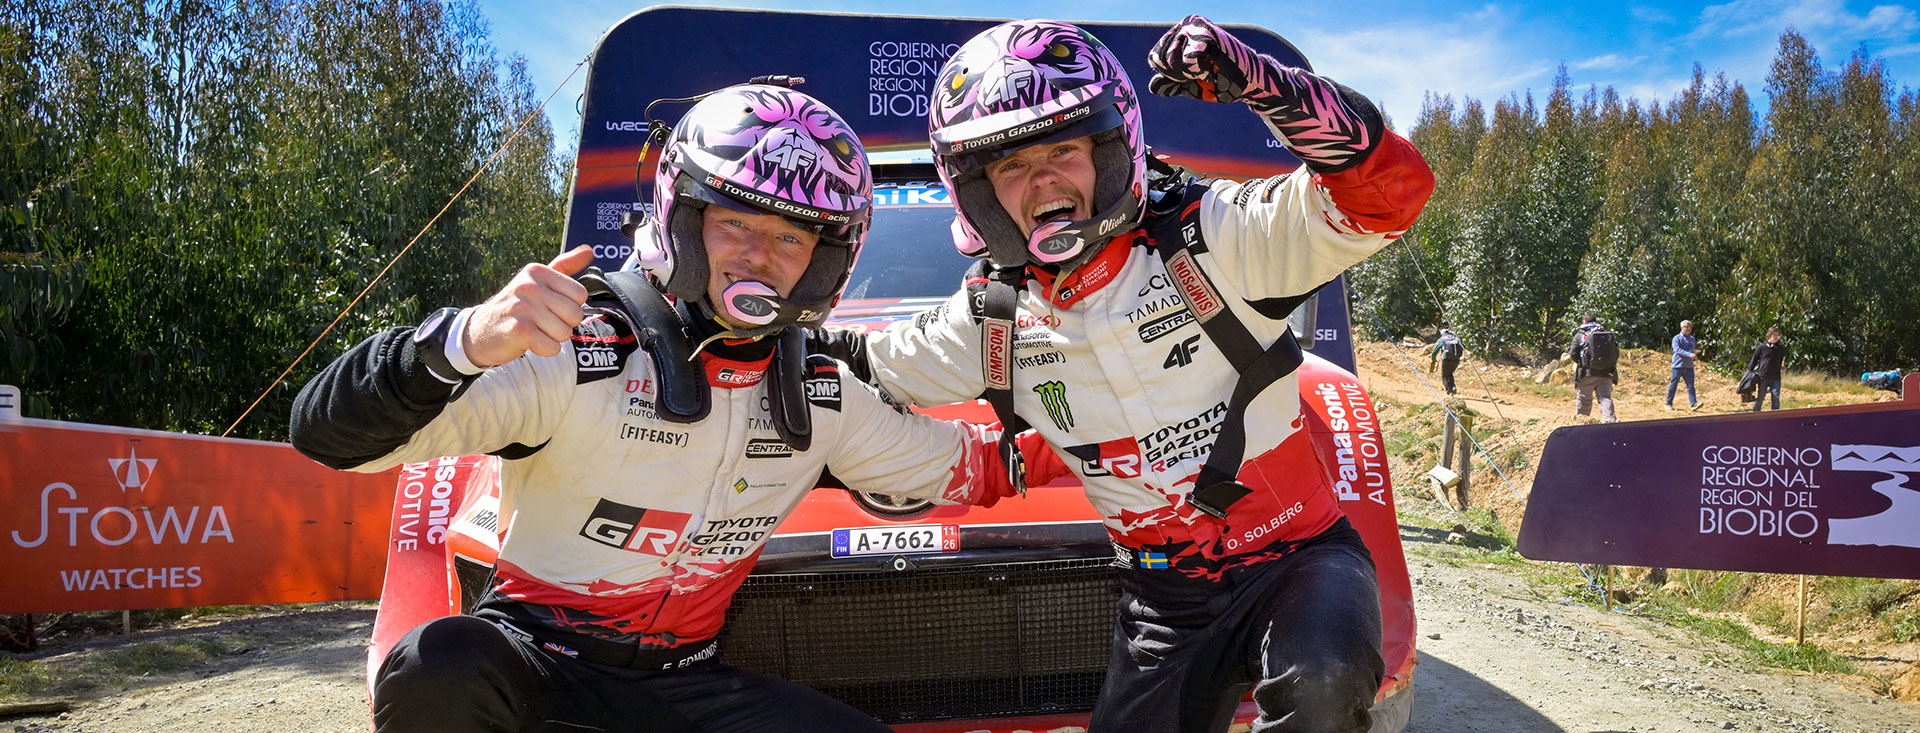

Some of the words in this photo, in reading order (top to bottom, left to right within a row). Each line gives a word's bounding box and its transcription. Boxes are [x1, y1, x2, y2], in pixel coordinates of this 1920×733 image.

[870, 59, 939, 76] REGION
[869, 77, 926, 92] REGION
[869, 93, 929, 117] BIOB
[964, 132, 1005, 150] TOYOTA
[1008, 119, 1053, 138] GAZOO
[1054, 105, 1090, 124] Racing
[724, 182, 771, 205] TOYOTA
[774, 200, 819, 218] GAZOO
[819, 212, 850, 225] Racing
[597, 221, 622, 230] BIOBI
[594, 245, 636, 259] COP
[1174, 260, 1213, 312] SIMPSON
[1125, 295, 1181, 323] TAMAD
[1013, 330, 1051, 341] anasonic
[1139, 313, 1195, 340] CENTRA
[577, 350, 618, 367] OMP
[990, 328, 1004, 382] SIMPSON
[717, 370, 743, 384] GR
[1138, 401, 1228, 450] TOYOTA
[1315, 382, 1360, 501] Panasonic
[1340, 382, 1386, 505] AUTOMOTIVE
[1151, 443, 1215, 473] Racin
[1701, 445, 1822, 467] GOBIERNO
[1701, 466, 1820, 489] REGIONAL
[398, 462, 429, 553] MOTIVE
[1700, 489, 1773, 507] REGION
[1784, 491, 1818, 508] DEL
[12, 482, 234, 548] STOWA
[1227, 538, 1242, 550] O.
[1244, 501, 1304, 543] SOLBERG
[1700, 507, 1819, 538] BIOBIO
[582, 514, 681, 557] GR
[856, 531, 934, 551] A-7662
[943, 527, 954, 536] 11
[943, 539, 956, 549] 26
[60, 566, 202, 592] WATCHES
